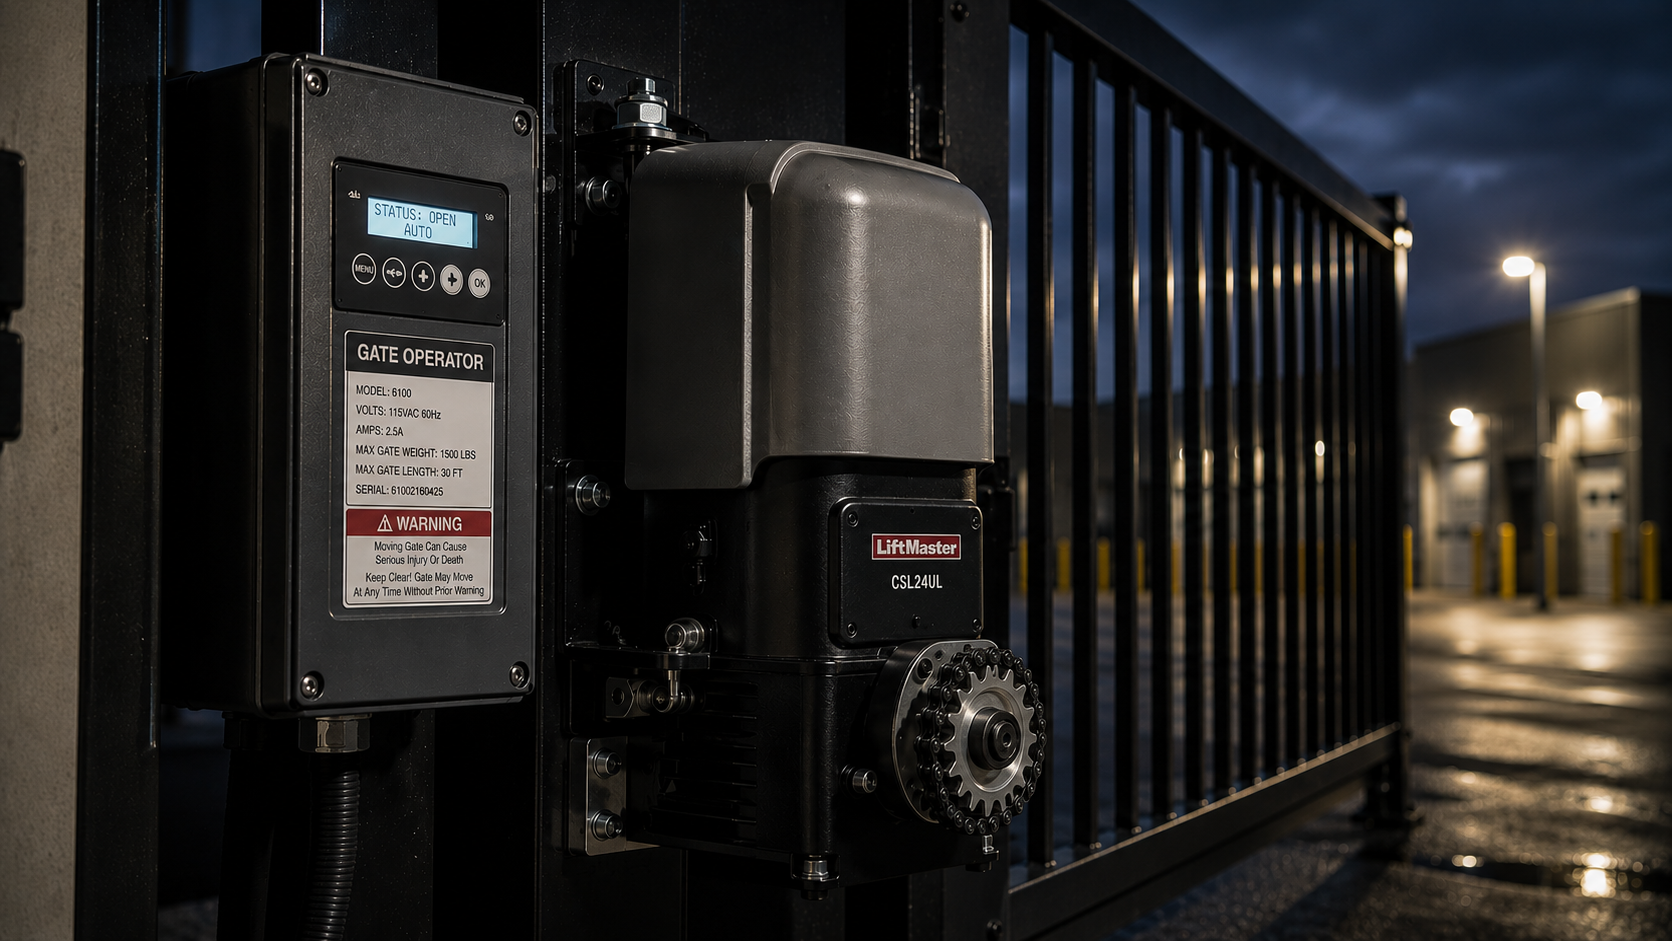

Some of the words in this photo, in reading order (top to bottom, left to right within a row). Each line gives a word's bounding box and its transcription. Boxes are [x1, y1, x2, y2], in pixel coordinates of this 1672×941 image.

[375, 203, 421, 220] STATUS:
[429, 211, 456, 226] OPEN
[404, 223, 432, 238] AUTO
[355, 264, 374, 274] MENU
[475, 278, 486, 288] OK
[358, 344, 398, 363] GATE
[403, 348, 483, 370] OPERATOR
[356, 385, 389, 396] MODEL:
[392, 388, 411, 397] 6100
[356, 405, 386, 416] VOLTS:
[389, 408, 419, 418] 115VAC
[422, 410, 441, 419] 60Hz
[356, 425, 383, 435] AMPS:
[386, 427, 403, 436] 2.5A
[356, 445, 374, 454] MAX
[378, 446, 399, 456] GATE
[402, 447, 437, 458] WEIGHT:
[441, 450, 458, 459] 1500
[461, 450, 476, 459] LBS
[356, 465, 374, 474] MAX
[377, 466, 399, 475] GATE
[403, 466, 438, 477] LENGTH:
[441, 468, 450, 477] 30
[453, 469, 462, 477] FT
[356, 485, 389, 495] SERIAL:
[392, 486, 443, 496] 61002160425
[396, 516, 462, 531] WARNING
[374, 542, 402, 553] Moving
[405, 542, 423, 551] Gate
[426, 542, 440, 551] Can
[443, 542, 467, 551] Cause
[877, 539, 956, 554] LiftMaster
[376, 555, 405, 565] Serious
[408, 555, 427, 567] Injury
[430, 555, 439, 564] Or
[442, 555, 463, 564] Death
[366, 573, 386, 584] Keep
[389, 572, 412, 582] Clear!
[414, 572, 432, 582] Gate
[435, 573, 451, 583] May
[453, 572, 473, 581] Move
[892, 575, 942, 589] CSL24UL
[353, 587, 362, 597] At
[364, 587, 380, 599] Any
[382, 587, 401, 596] Time
[404, 586, 433, 596] Without
[435, 586, 452, 595] Prior
[455, 586, 484, 597] Warning
